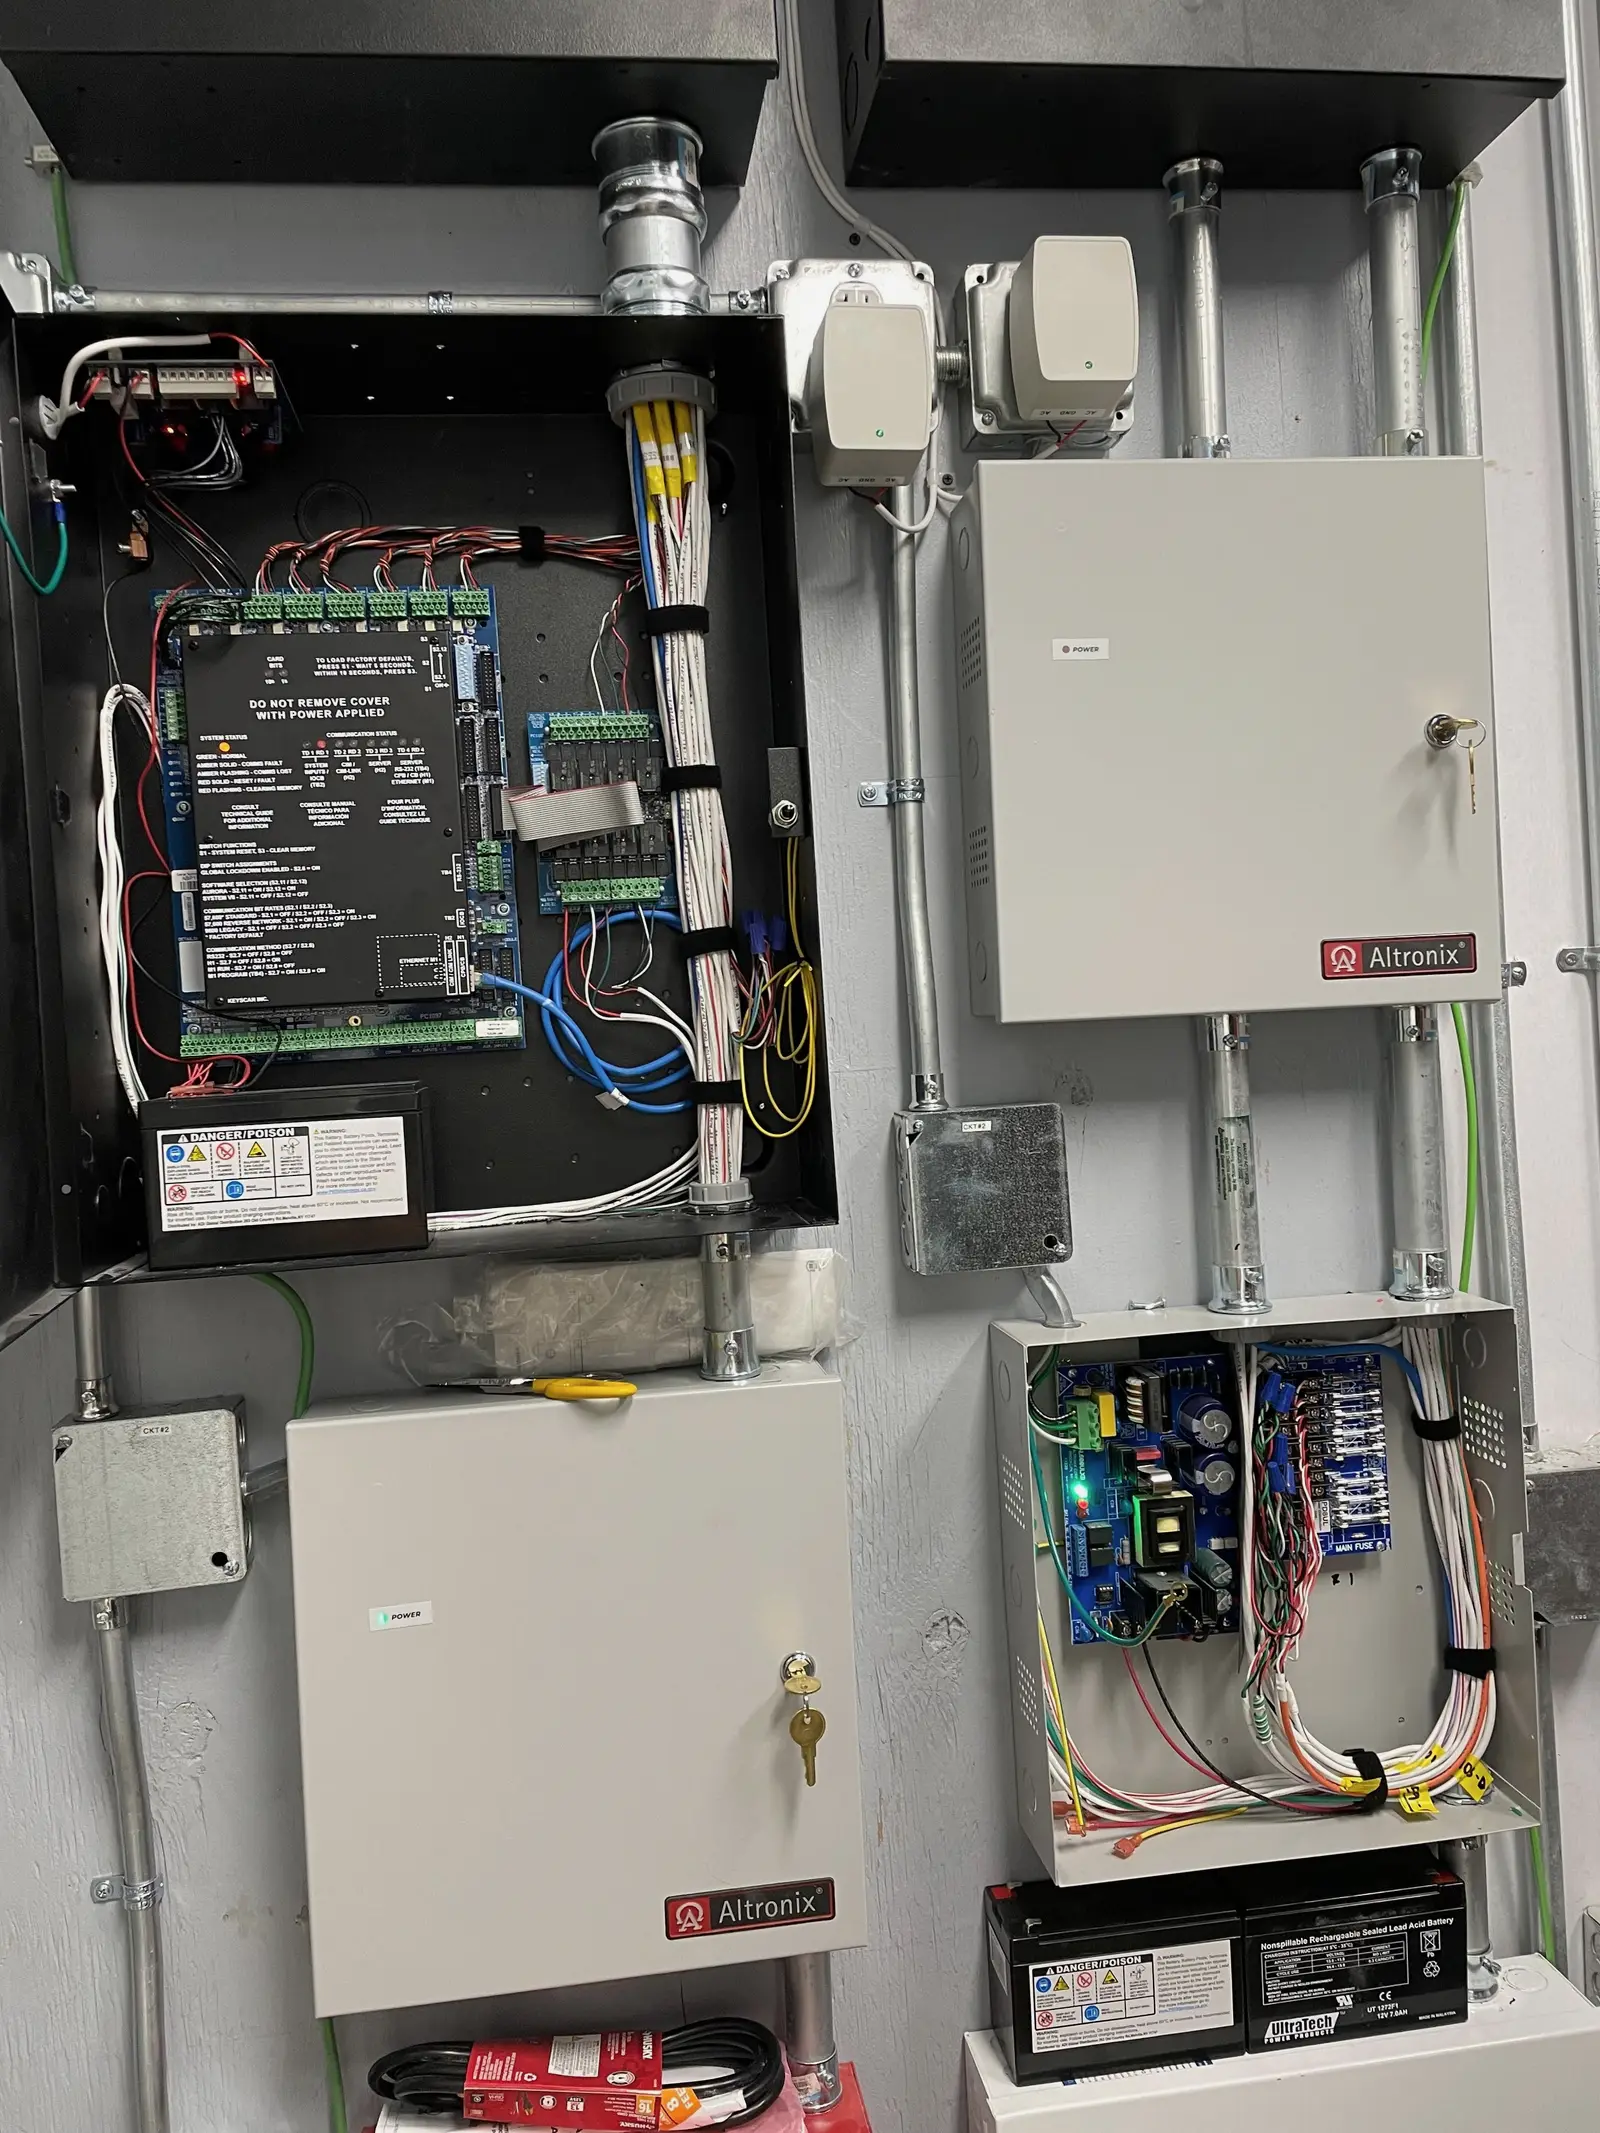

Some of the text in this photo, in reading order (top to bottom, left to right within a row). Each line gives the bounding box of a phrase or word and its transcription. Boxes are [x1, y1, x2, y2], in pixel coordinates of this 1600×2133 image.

[250, 697, 390, 709] DO NOT REMOVE COVER
[256, 708, 385, 720] WITH POWER APPLIED
[1370, 944, 1459, 968] Altronix
[190, 1128, 295, 1142] DANGER/POISON
[1336, 1542, 1374, 1552] MAIN FUSE
[392, 1611, 421, 1620] POWER
[719, 1891, 816, 1923] Altronix
[1261, 1918, 1454, 1950] Nonspillable Rechargeable Sealed Lead Acid Battery
[1056, 1956, 1142, 1974] DANGER/POISON
[1377, 2003, 1398, 2011] 1272F1
[1271, 2015, 1333, 2035] UltraTech
[1264, 2029, 1334, 2044] POWER PRODUCTS
[639, 2101, 652, 2113] 16
